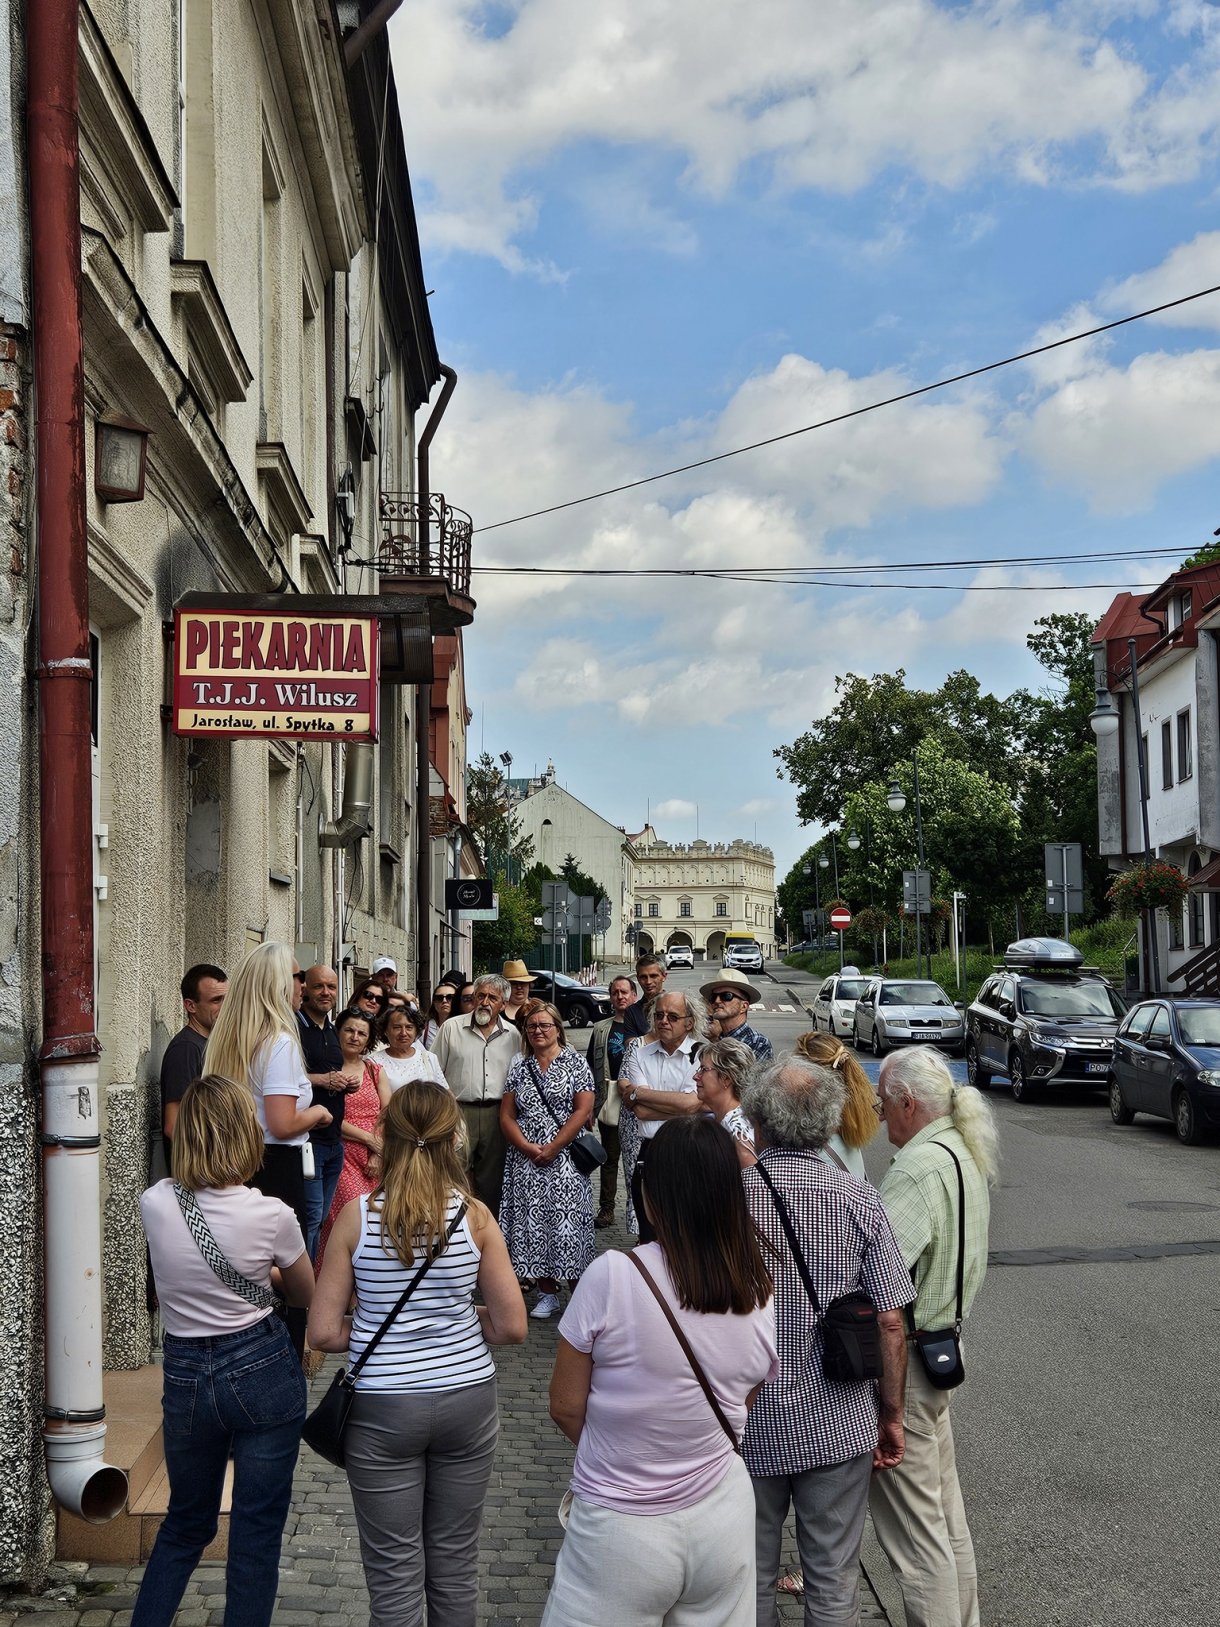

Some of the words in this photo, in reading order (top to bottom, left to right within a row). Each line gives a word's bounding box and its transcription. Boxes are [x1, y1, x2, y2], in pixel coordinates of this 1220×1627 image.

[186, 620, 367, 672] PIEKARNIA
[193, 682, 266, 705] T.J.J.
[275, 683, 358, 707] Wilusz
[191, 713, 257, 730] Jarosław,
[262, 715, 280, 729] ul.
[344, 719, 354, 732] 8
